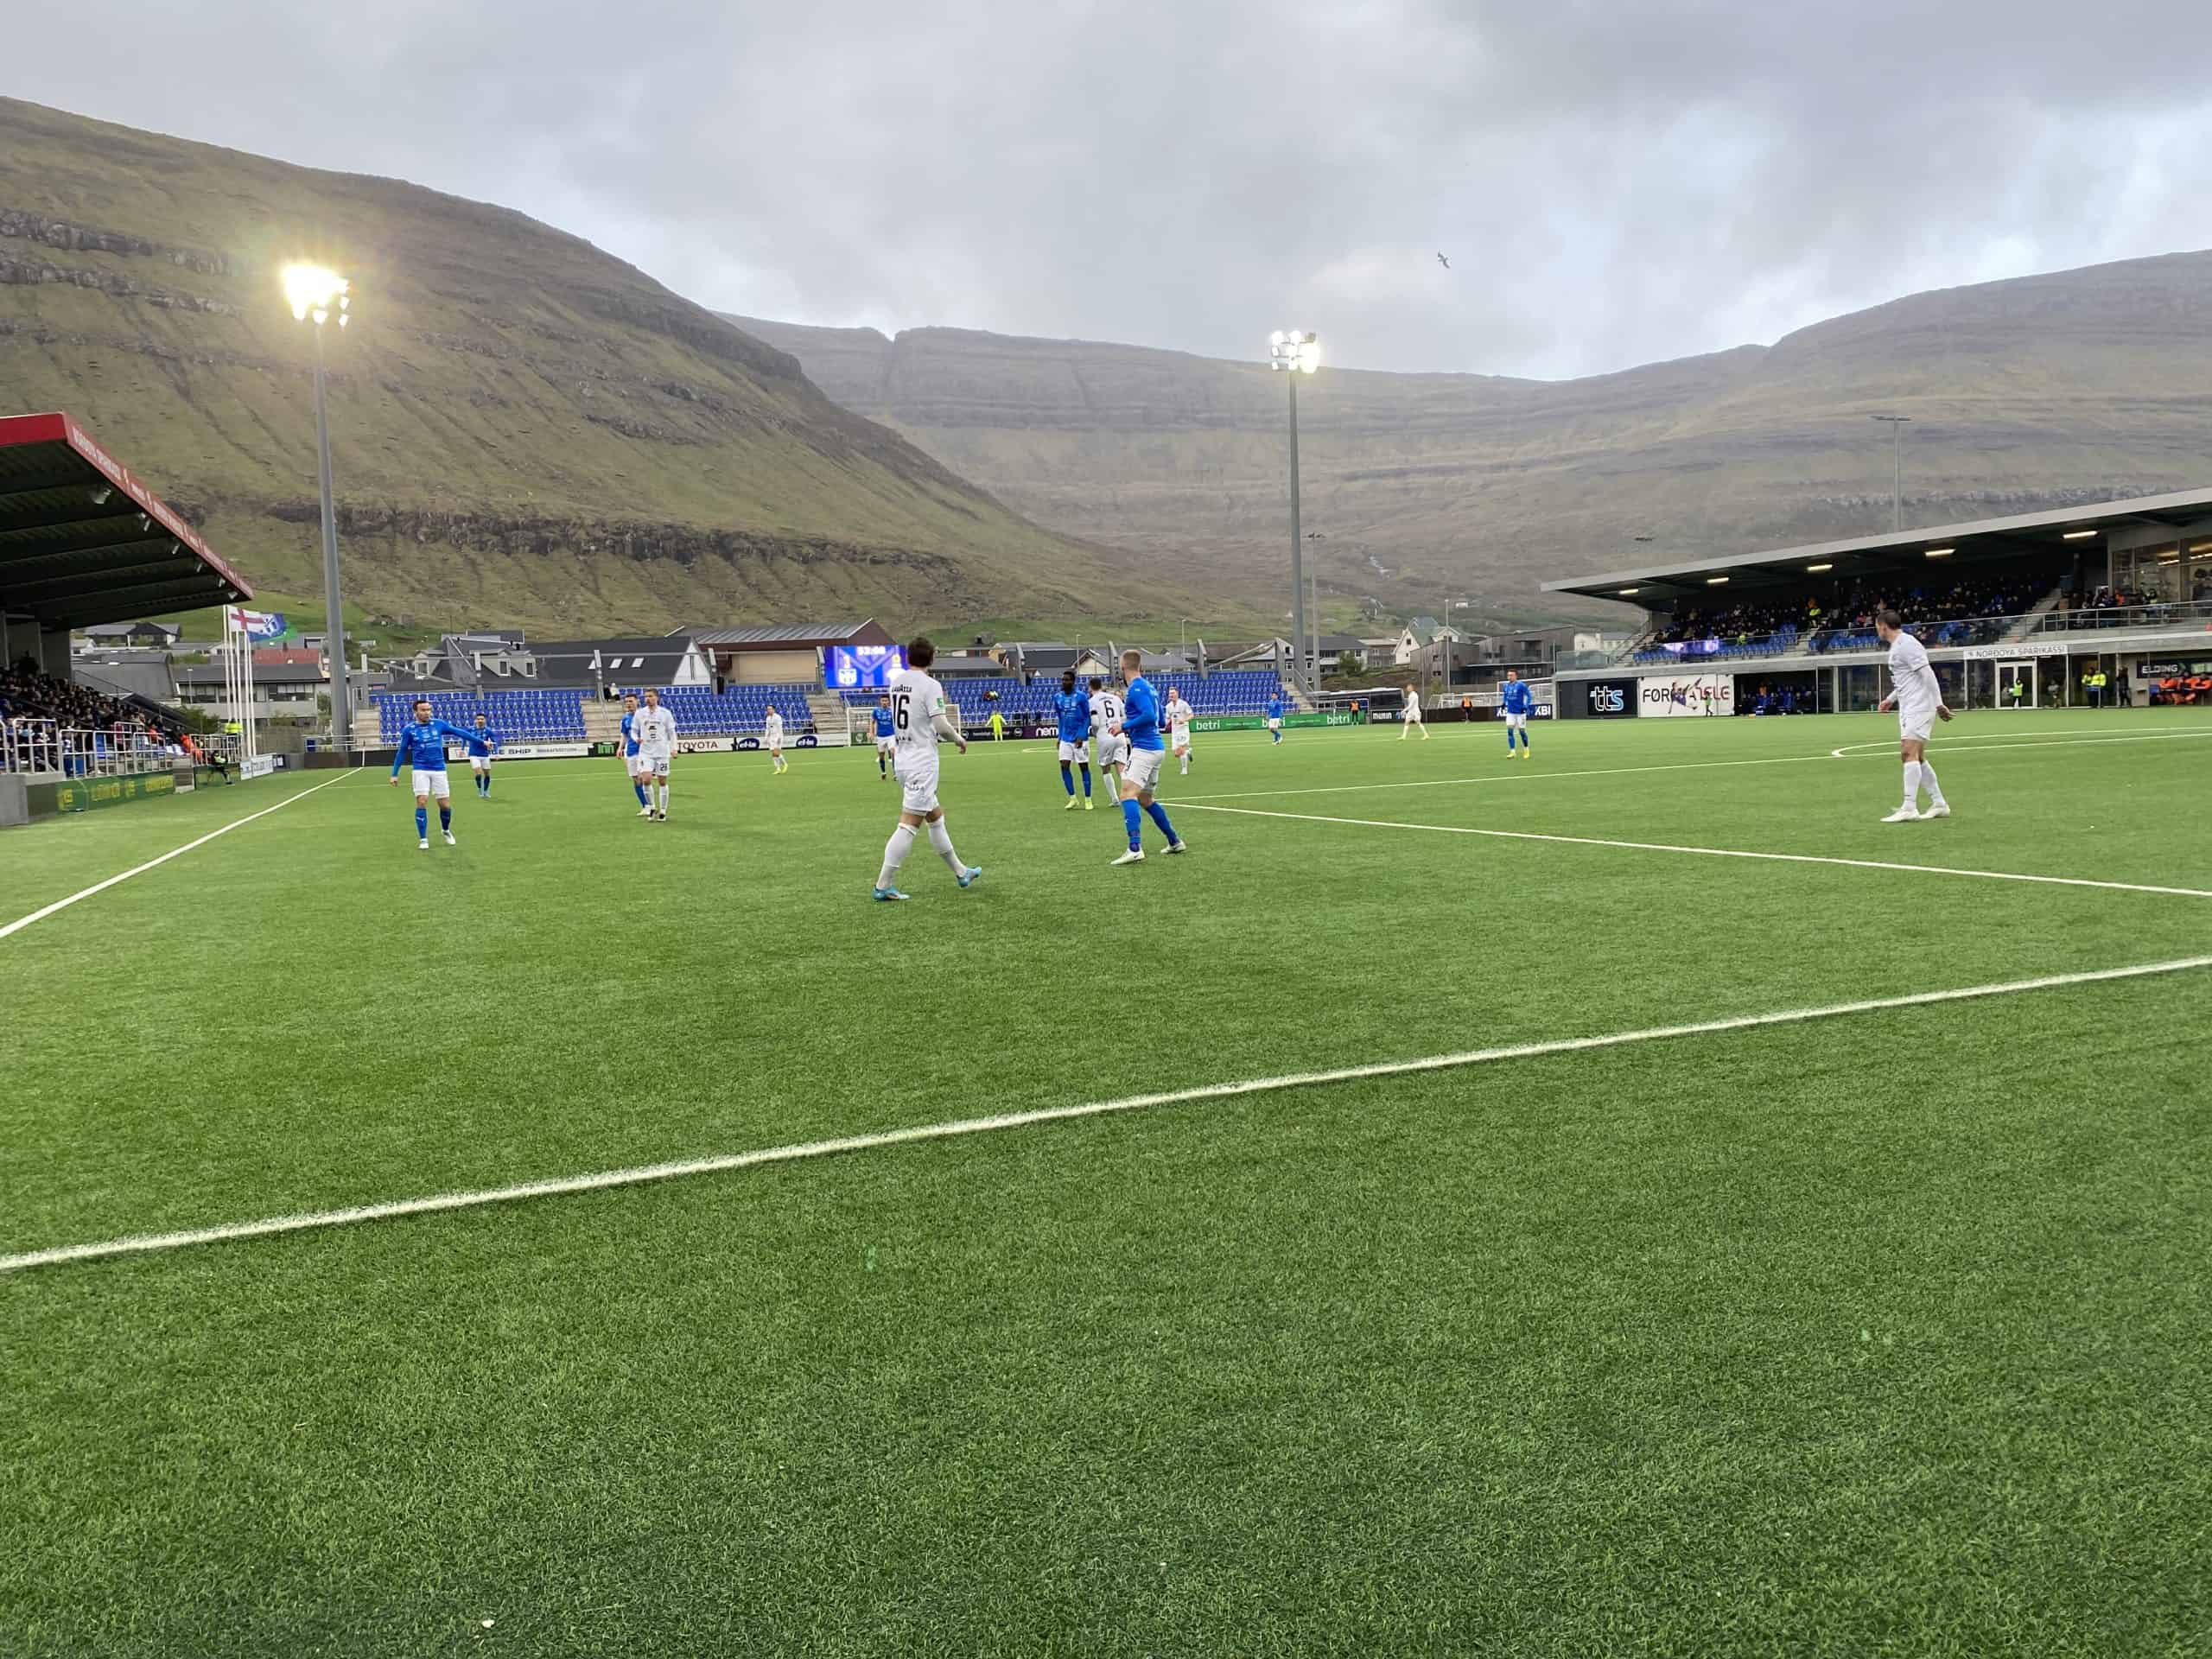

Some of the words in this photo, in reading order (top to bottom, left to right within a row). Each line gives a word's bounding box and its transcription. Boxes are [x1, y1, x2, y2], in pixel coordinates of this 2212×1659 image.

[1590, 686, 1624, 711] tts
[892, 694, 910, 730] 16
[1104, 700, 1115, 718] 6
[1196, 719, 1220, 730] betri
[677, 741, 719, 750] TOYOTA
